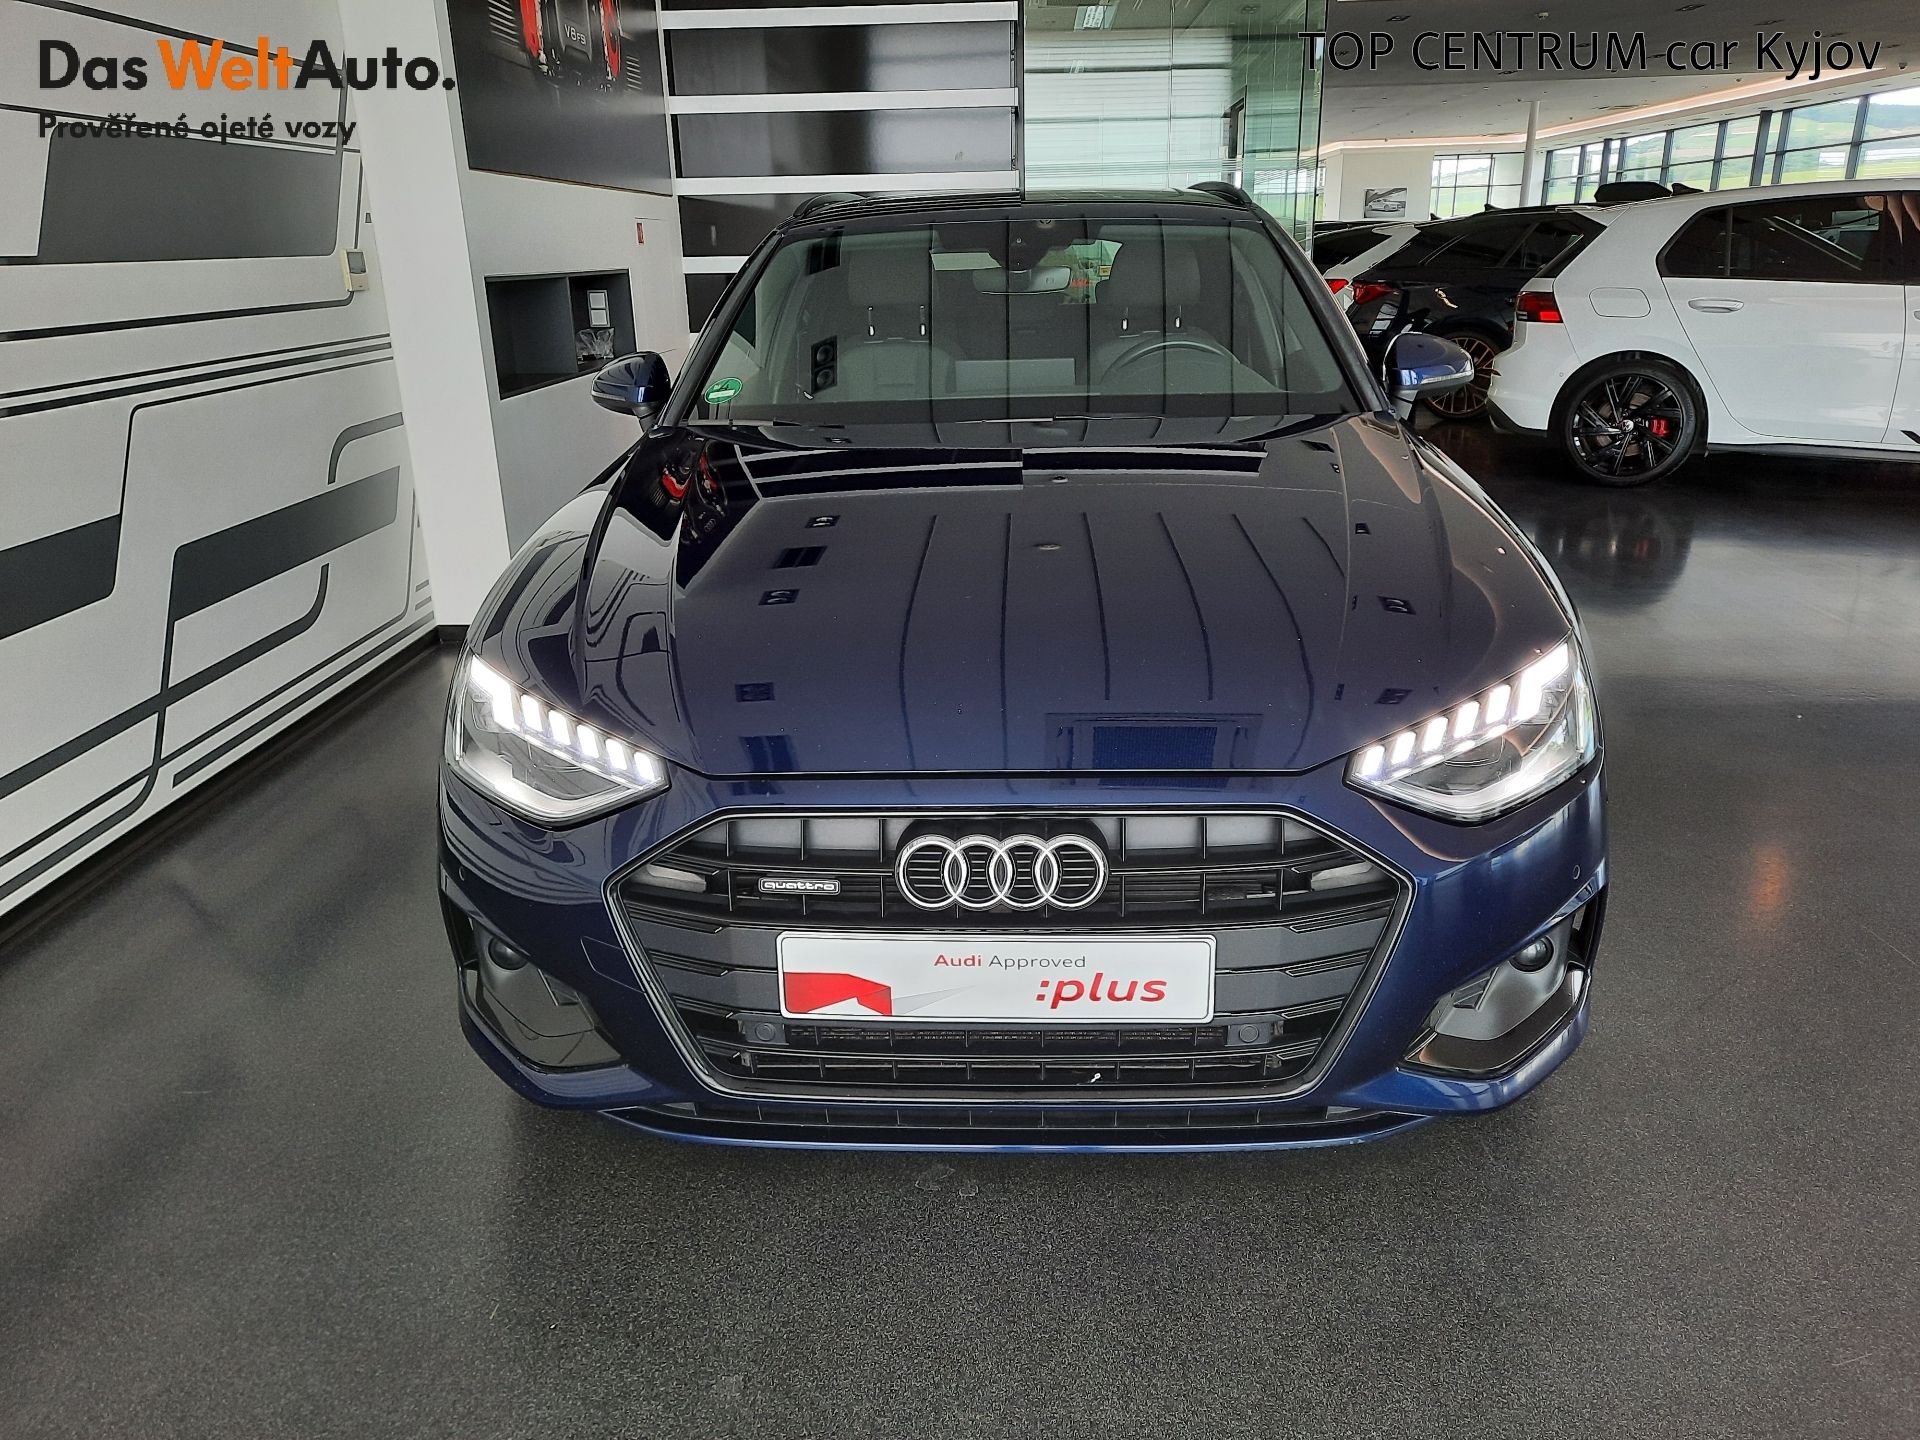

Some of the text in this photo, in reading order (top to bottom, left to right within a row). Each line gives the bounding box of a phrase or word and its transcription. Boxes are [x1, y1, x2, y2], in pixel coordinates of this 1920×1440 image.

[764, 881, 835, 891] quattro
[934, 954, 1087, 969] Audi Approved
